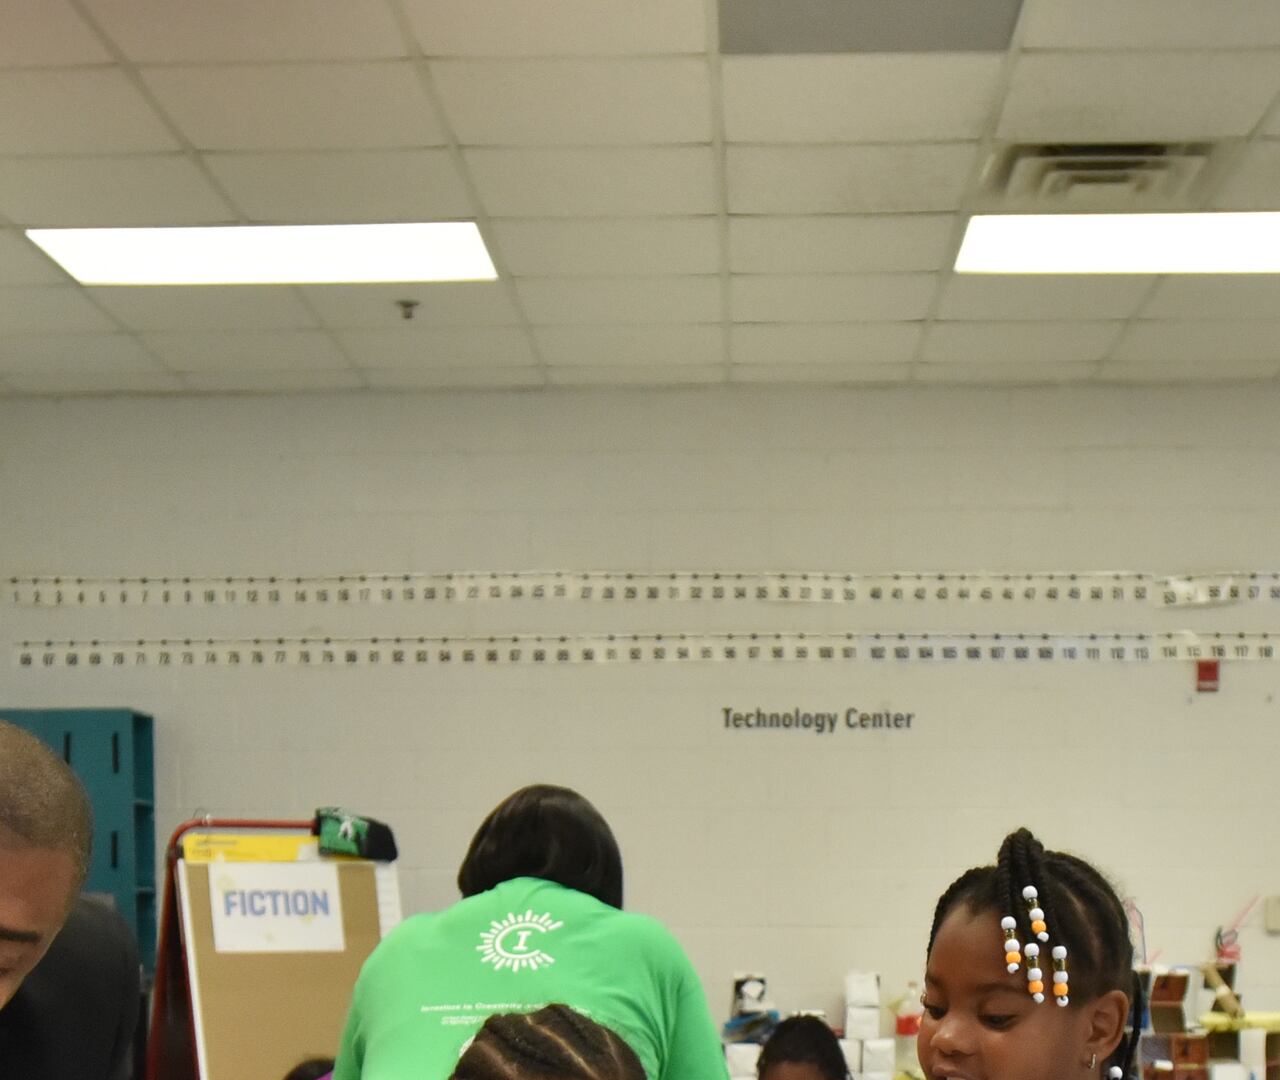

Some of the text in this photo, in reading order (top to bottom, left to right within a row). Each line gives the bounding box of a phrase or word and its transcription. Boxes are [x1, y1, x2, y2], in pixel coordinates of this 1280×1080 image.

[722, 707, 914, 733] Technology Center
[223, 889, 330, 918] FICTION
